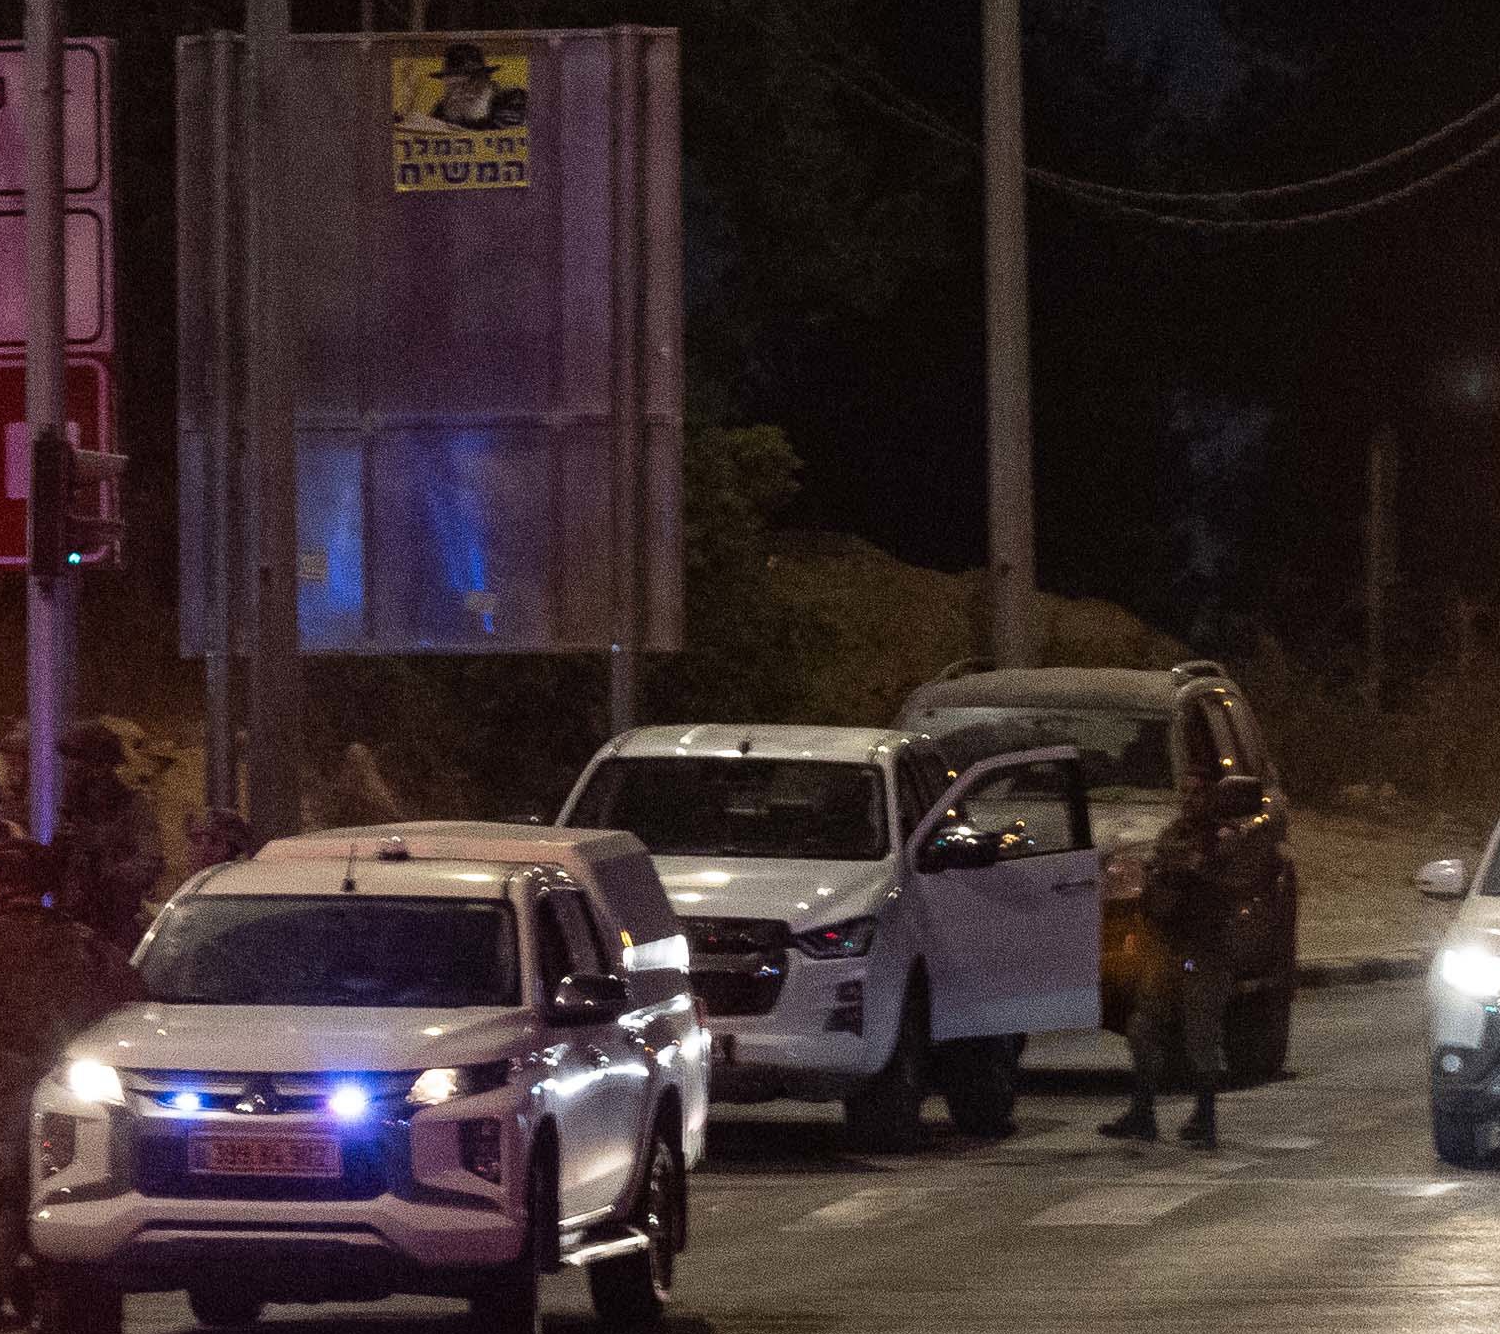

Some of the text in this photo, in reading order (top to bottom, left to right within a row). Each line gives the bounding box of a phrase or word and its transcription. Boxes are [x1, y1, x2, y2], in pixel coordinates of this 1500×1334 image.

[395, 137, 527, 159] יחי המלך
[396, 159, 525, 185] המשיח
